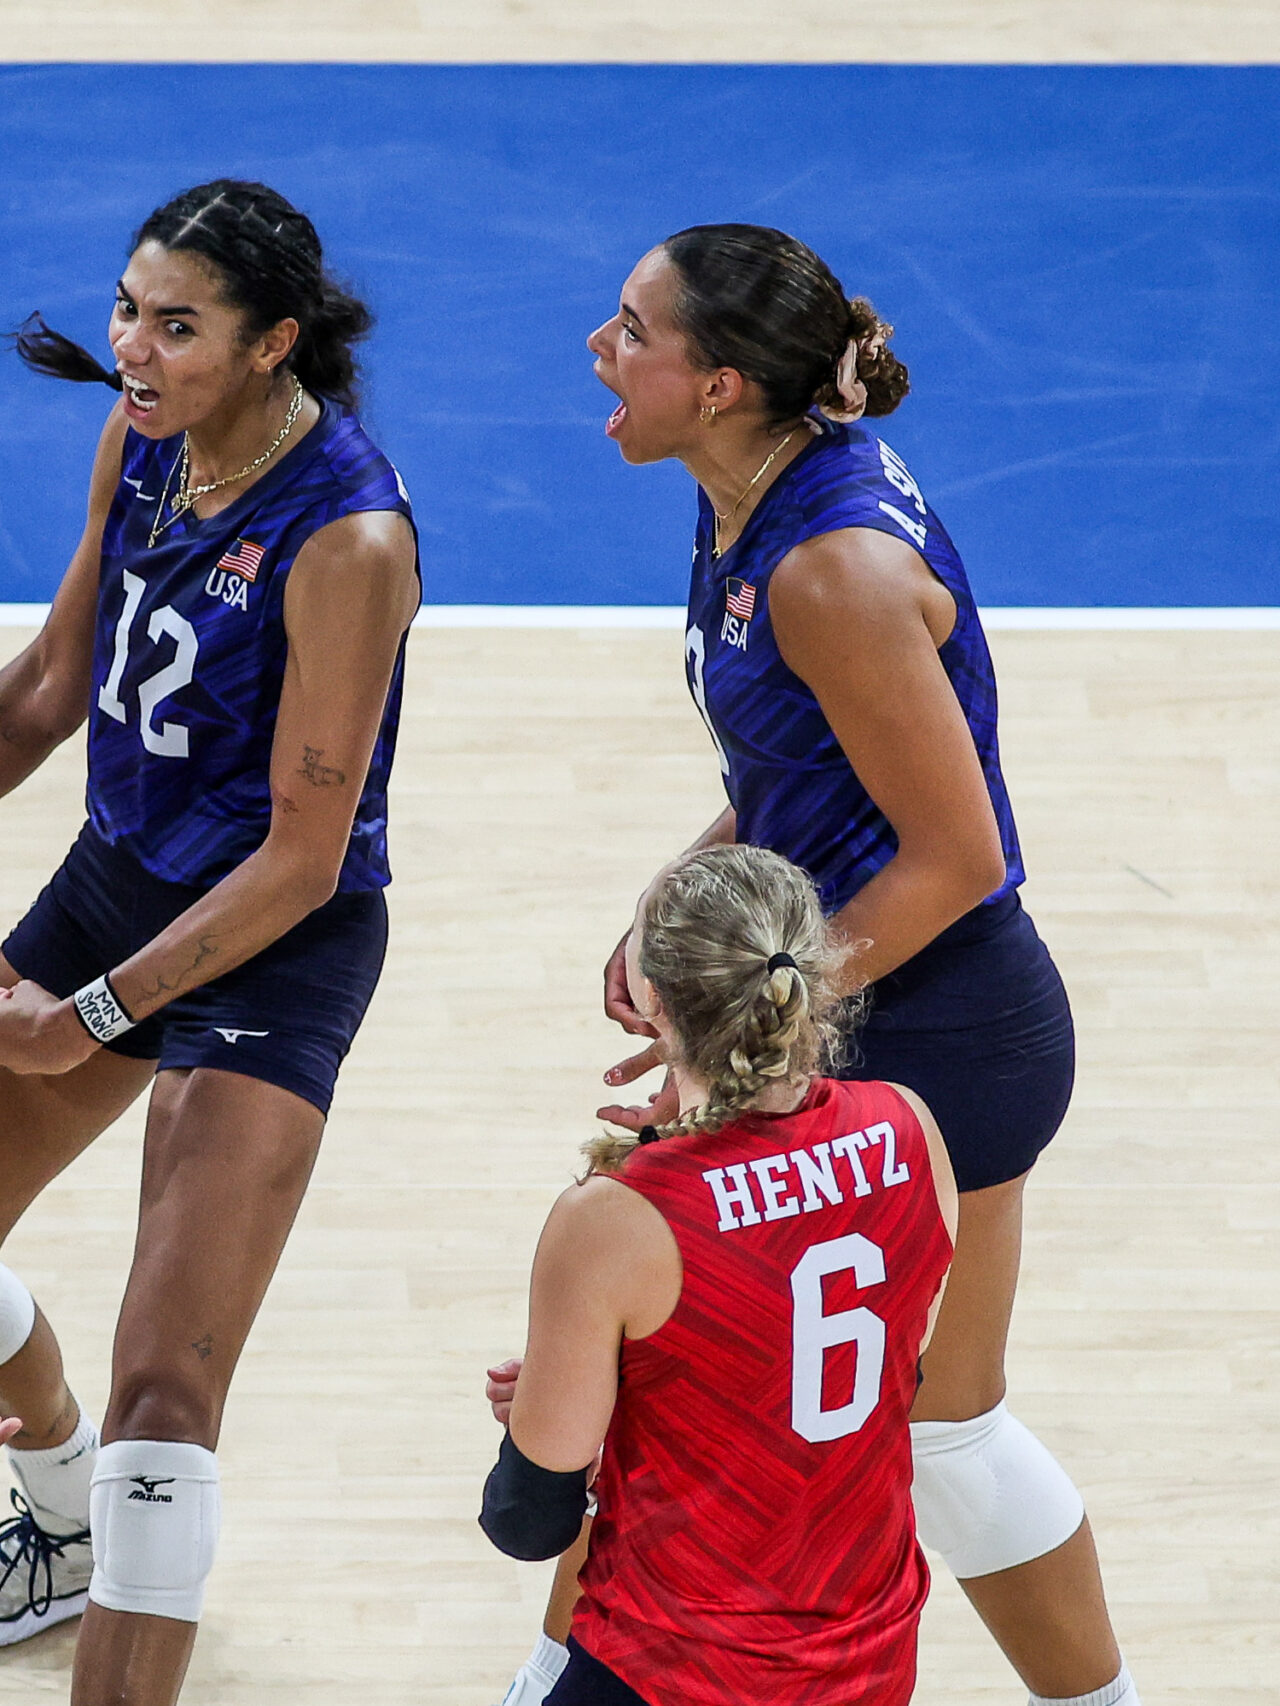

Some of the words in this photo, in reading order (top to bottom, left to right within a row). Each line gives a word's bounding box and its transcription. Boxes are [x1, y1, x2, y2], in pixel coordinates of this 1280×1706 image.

[205, 567, 247, 611] USA
[720, 611, 749, 651] USA
[98, 568, 199, 758] 12
[78, 991, 116, 1038] STRONG
[94, 990, 123, 1024] MN
[702, 1121, 911, 1232] HENTZ
[789, 1232, 887, 1443] 6
